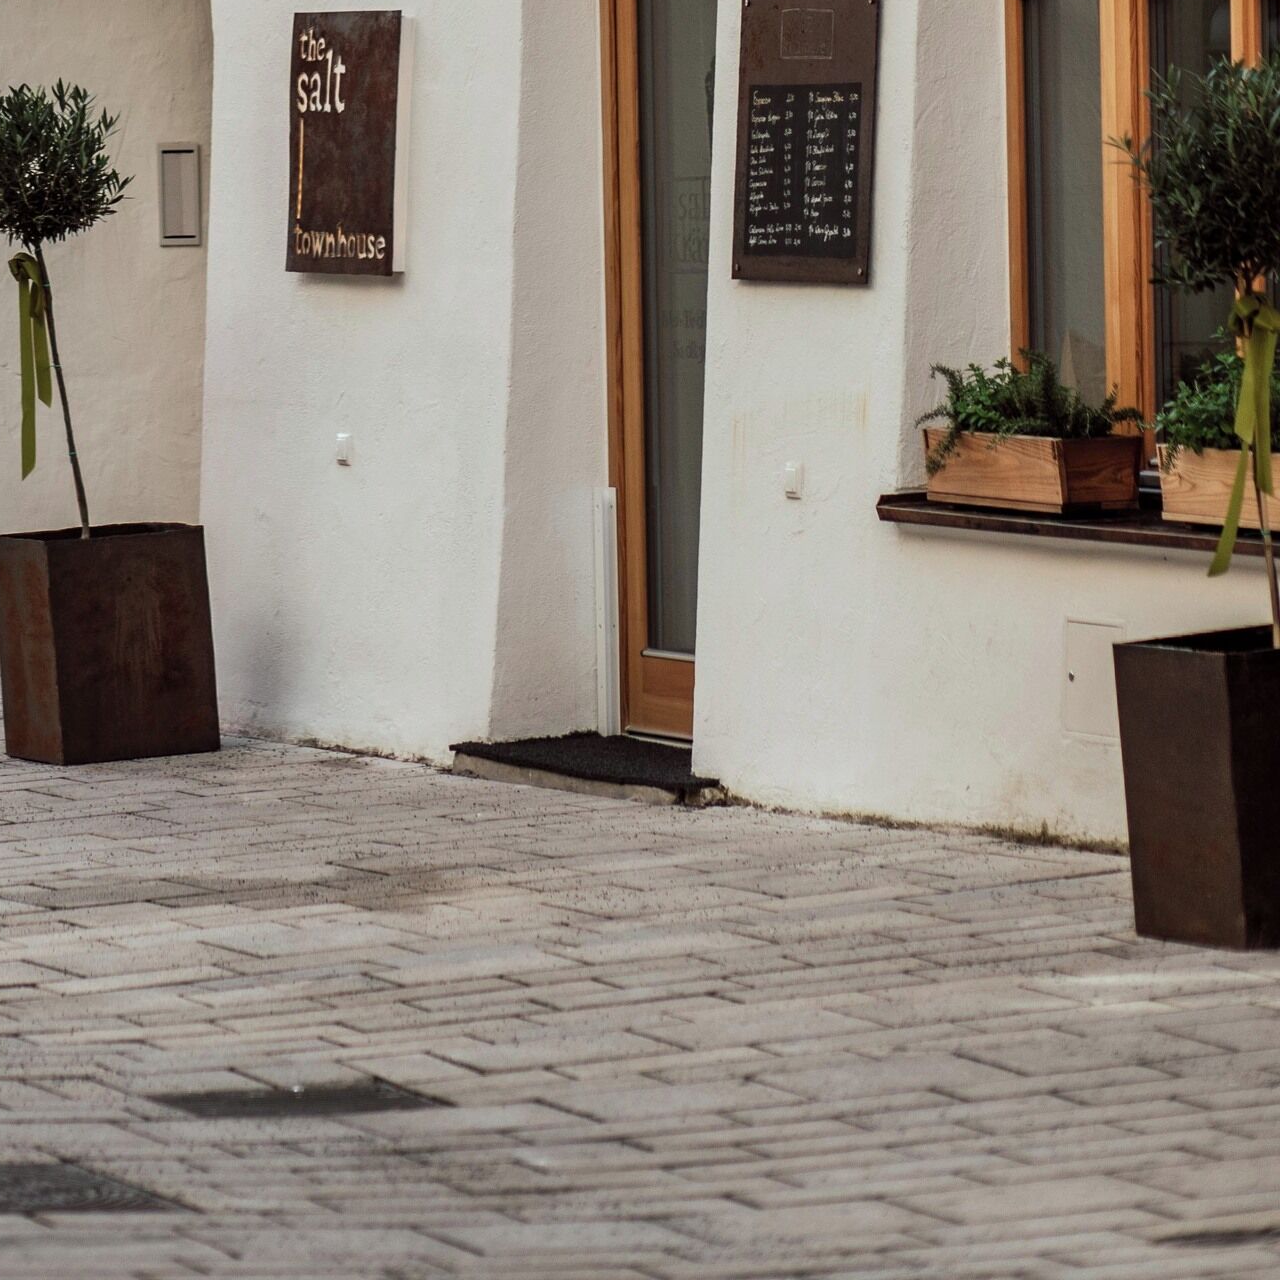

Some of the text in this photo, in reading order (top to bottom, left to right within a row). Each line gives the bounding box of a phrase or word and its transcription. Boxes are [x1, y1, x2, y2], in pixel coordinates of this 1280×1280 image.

[299, 27, 326, 62] the
[296, 48, 346, 114] salt
[293, 222, 386, 260] townhouse
